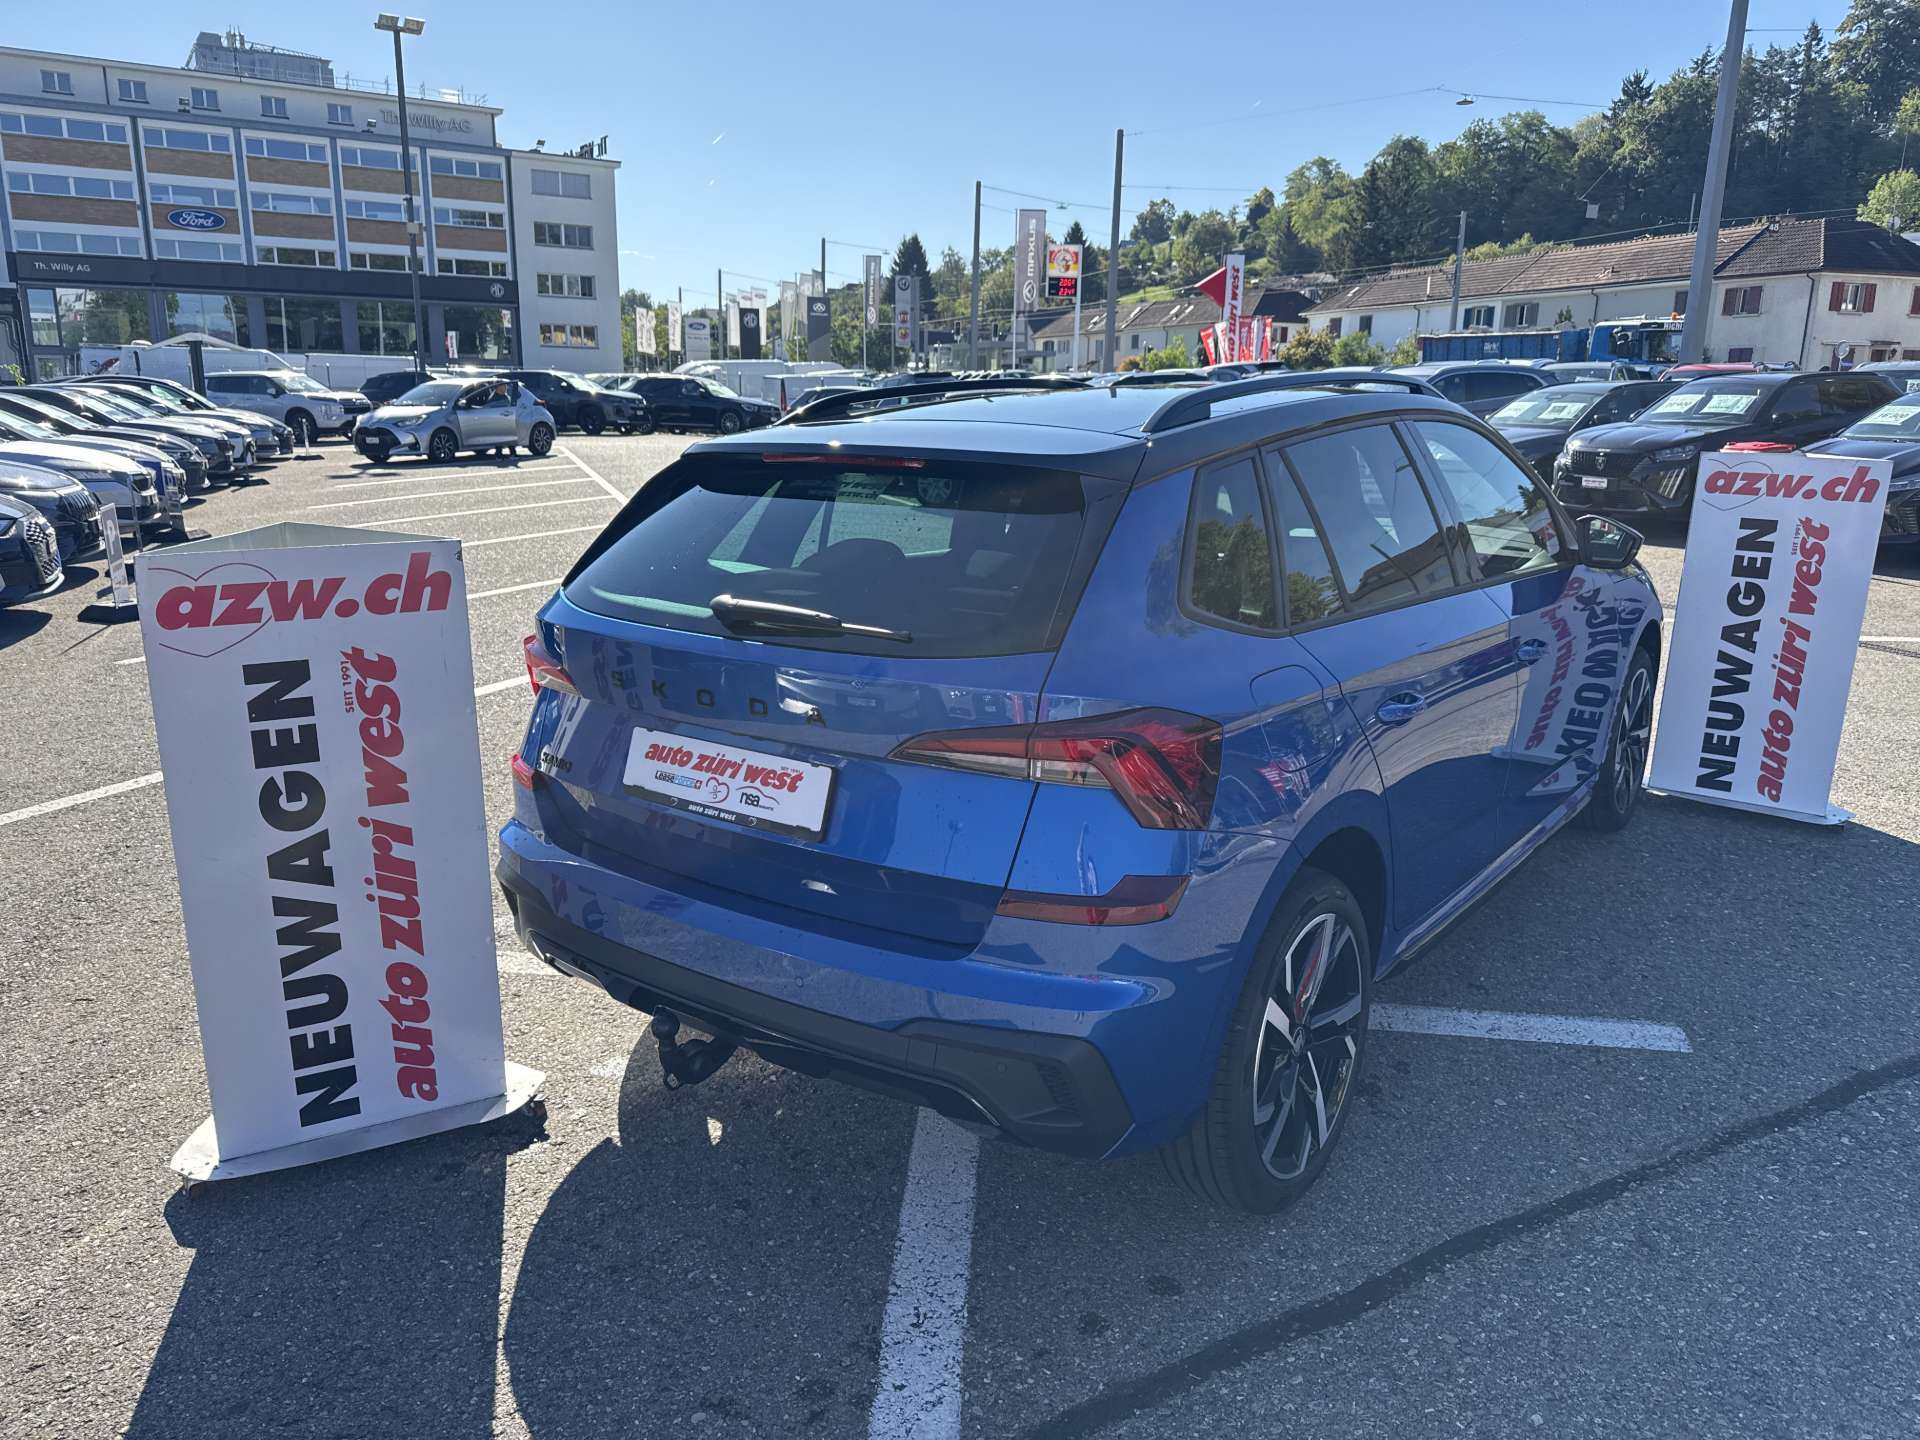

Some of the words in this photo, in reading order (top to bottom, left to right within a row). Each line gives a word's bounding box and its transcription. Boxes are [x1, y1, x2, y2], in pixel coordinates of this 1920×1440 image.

[380, 109, 398, 124] Th
[179, 211, 215, 227] Ford
[34, 262, 49, 270] Th.
[50, 262, 74, 273] Willy
[76, 264, 91, 272] AG
[1232, 263, 1240, 301] west
[1704, 466, 1880, 503] azw.ch
[156, 552, 452, 631] azw.ch
[1788, 516, 1830, 616] west
[340, 660, 352, 687] 1991
[1695, 517, 1779, 793] NEUWAGEN
[1771, 617, 1811, 711] züri
[340, 646, 411, 808] west
[344, 690, 355, 713] SEIT
[645, 742, 693, 768] auto
[690, 752, 748, 780] züri
[743, 763, 807, 793] west
[1756, 709, 1794, 803] auto
[688, 803, 703, 813] auto
[719, 811, 737, 821] west
[739, 791, 760, 807] nsa
[242, 659, 362, 1128] NEUWAGEN
[358, 816, 425, 957] züri
[378, 961, 439, 1101] auto
